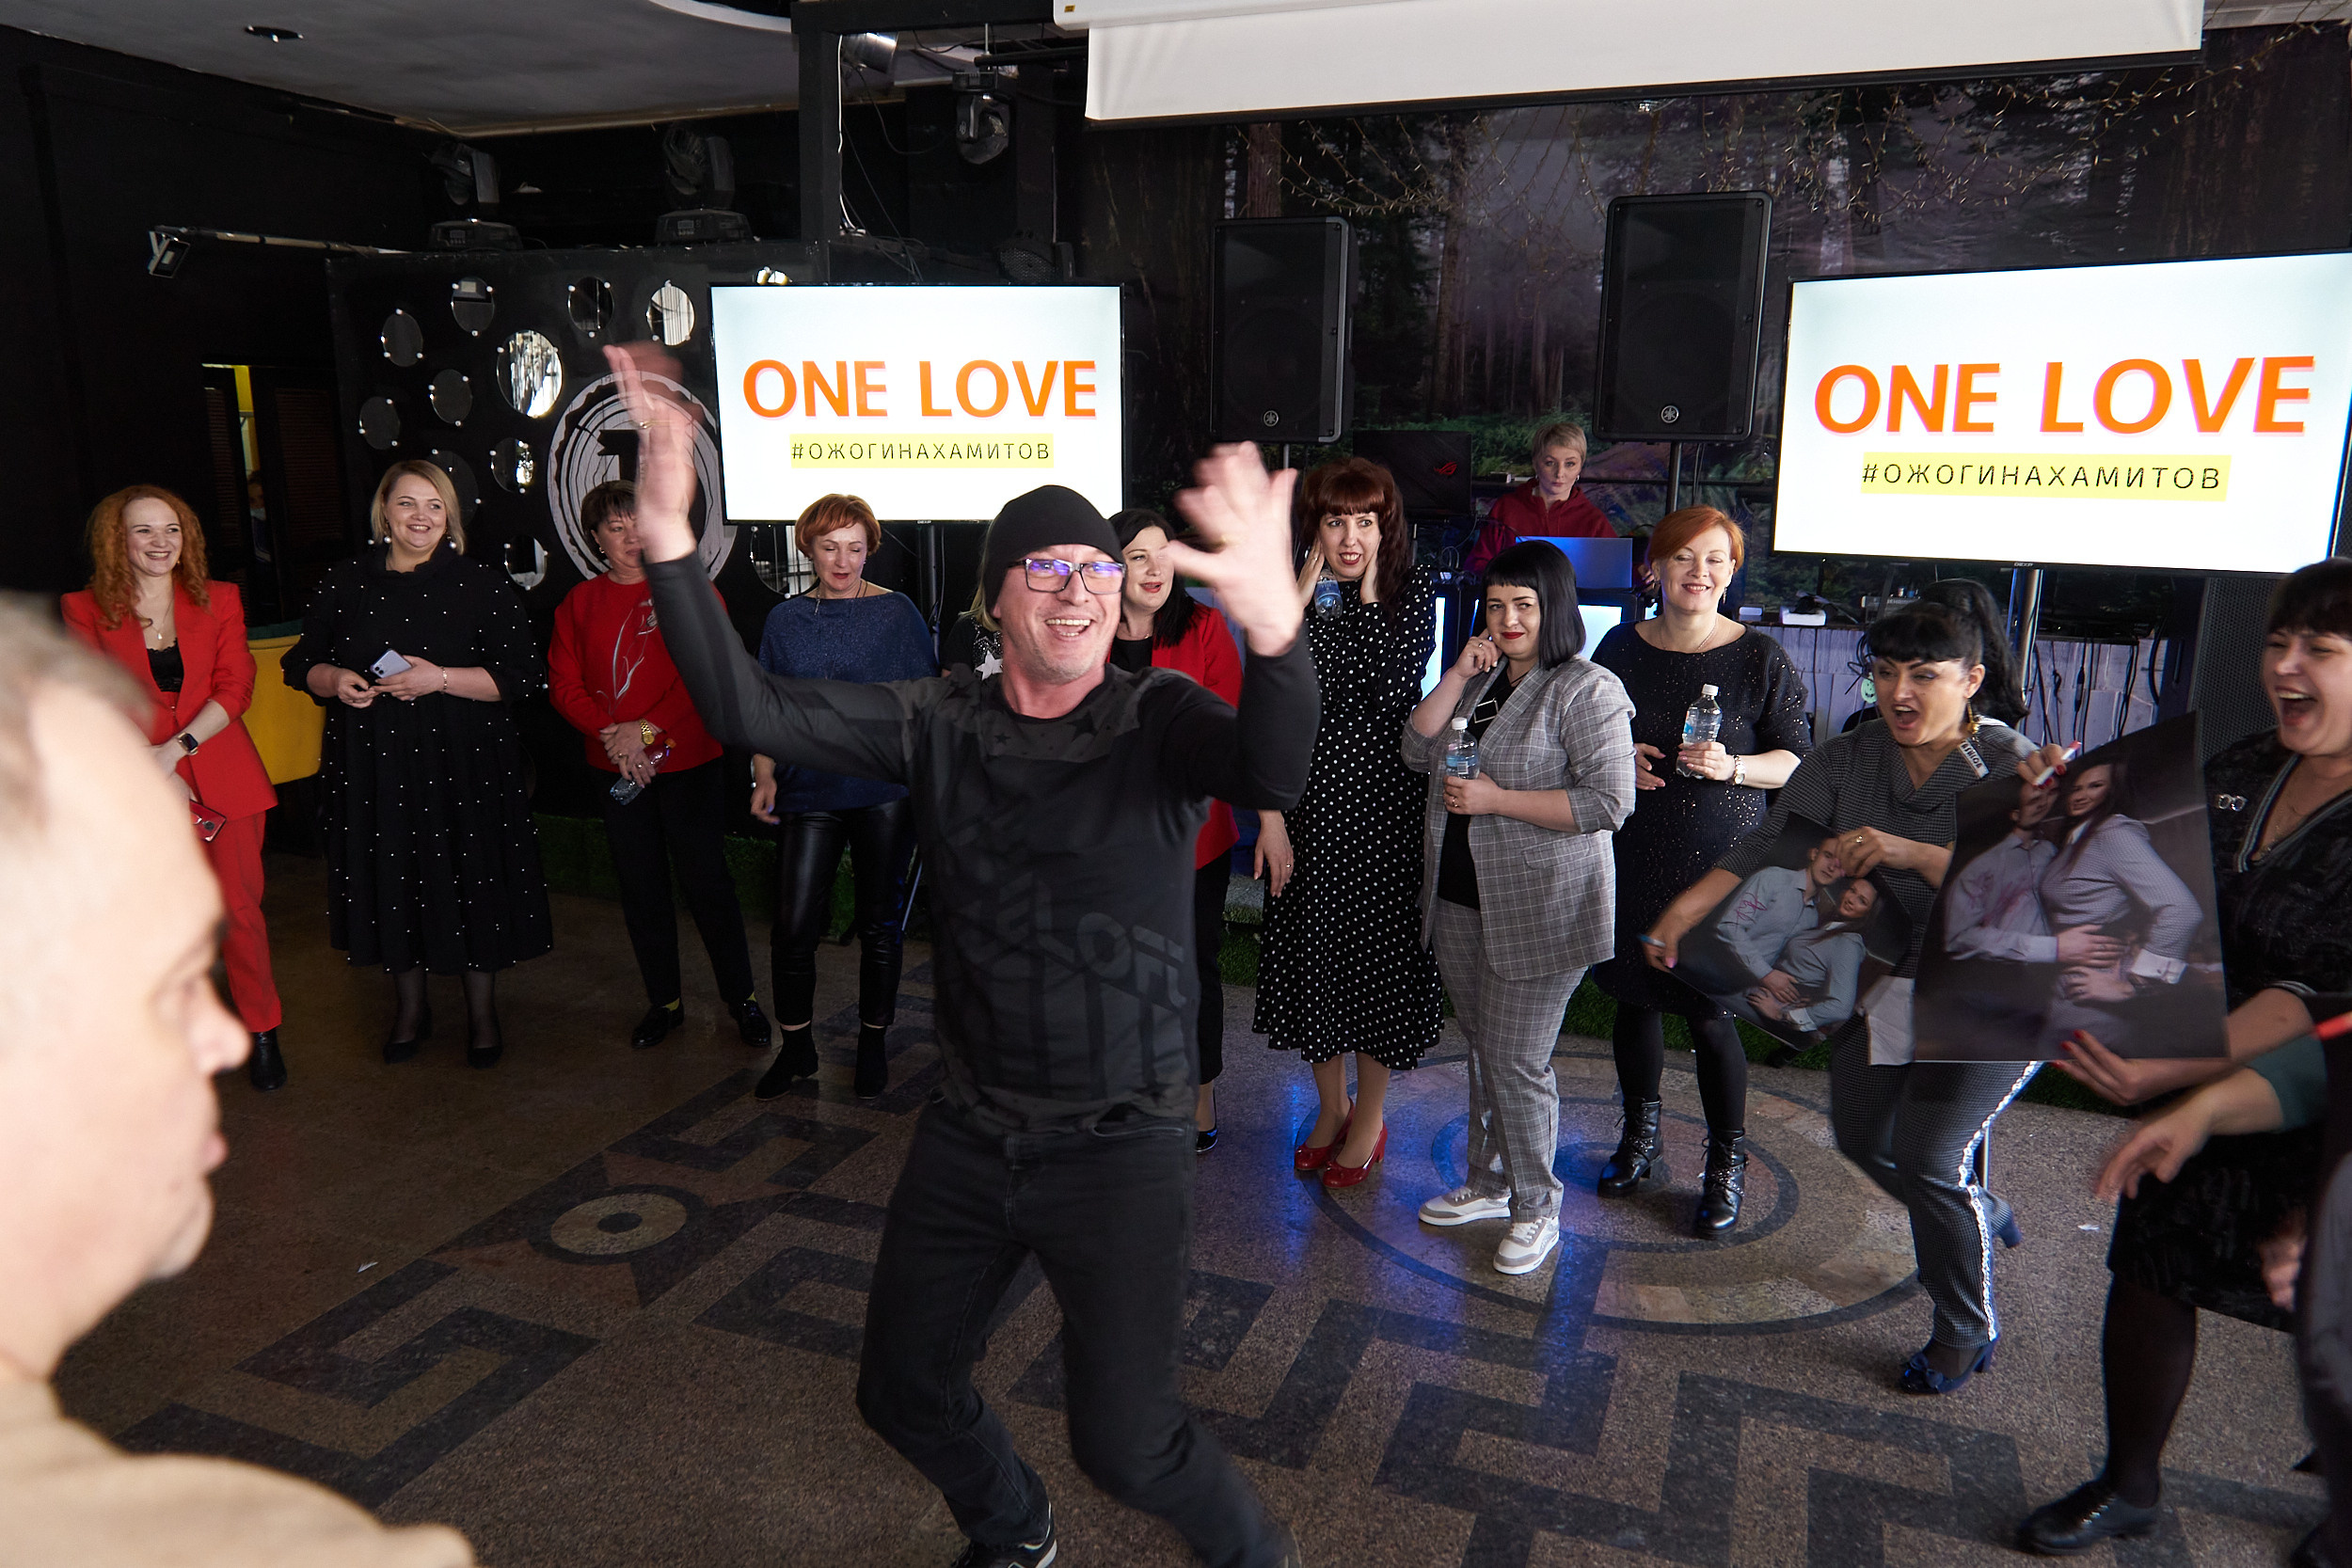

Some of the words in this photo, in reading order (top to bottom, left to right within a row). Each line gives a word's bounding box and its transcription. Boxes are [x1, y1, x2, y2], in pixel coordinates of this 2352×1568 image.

[742, 359, 887, 418] ONE
[919, 359, 1097, 418] LOVE
[1815, 363, 2000, 434] ONE
[2040, 356, 2315, 435] LOVE
[791, 442, 1050, 460] #ОЖОГИНАХАМИТОВ
[1862, 462, 2220, 490] #ОЖОГИНАХАМИТОВ
